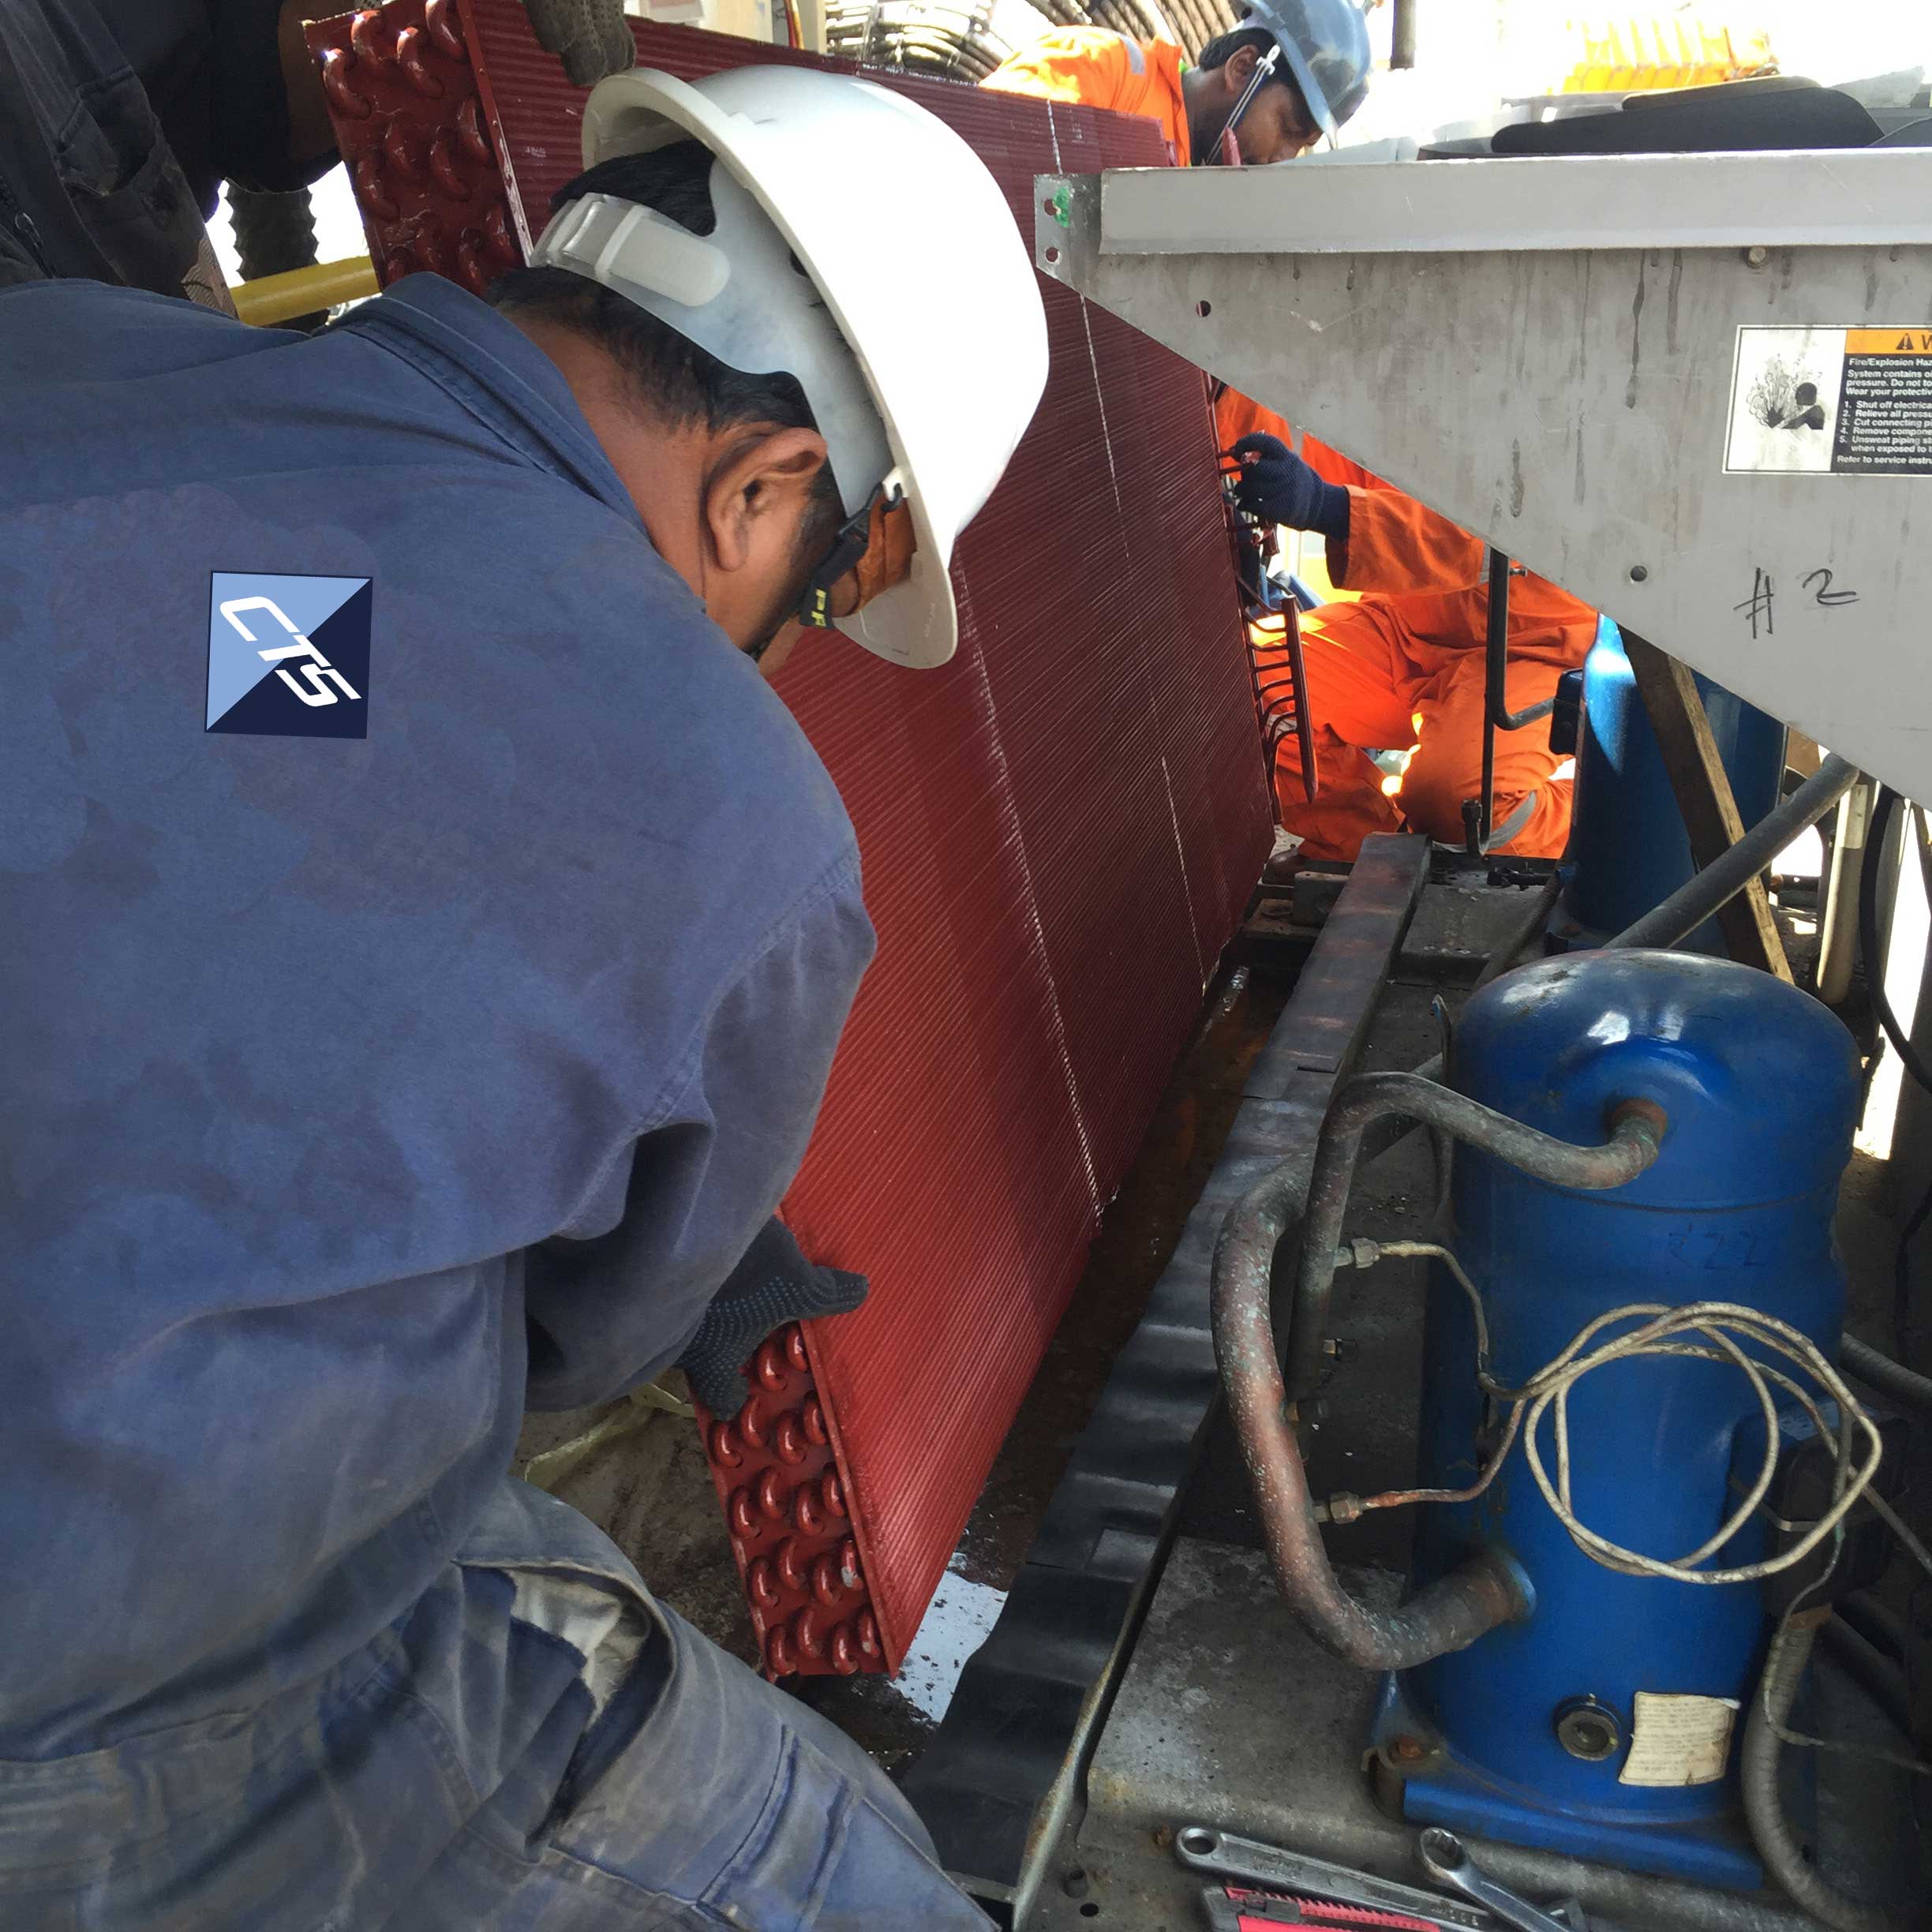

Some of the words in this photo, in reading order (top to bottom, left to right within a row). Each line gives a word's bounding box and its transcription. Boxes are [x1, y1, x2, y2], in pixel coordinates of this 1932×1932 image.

[1848, 358, 1914, 368] Fire/Explosion
[1848, 369, 1881, 379] System
[1870, 388, 1891, 397] your
[1871, 418, 1922, 428] connecting
[1852, 426, 1889, 435] Remove
[1892, 436, 1920, 445] piping
[1877, 445, 1915, 454] exposed
[1837, 455, 1861, 463] Refer
